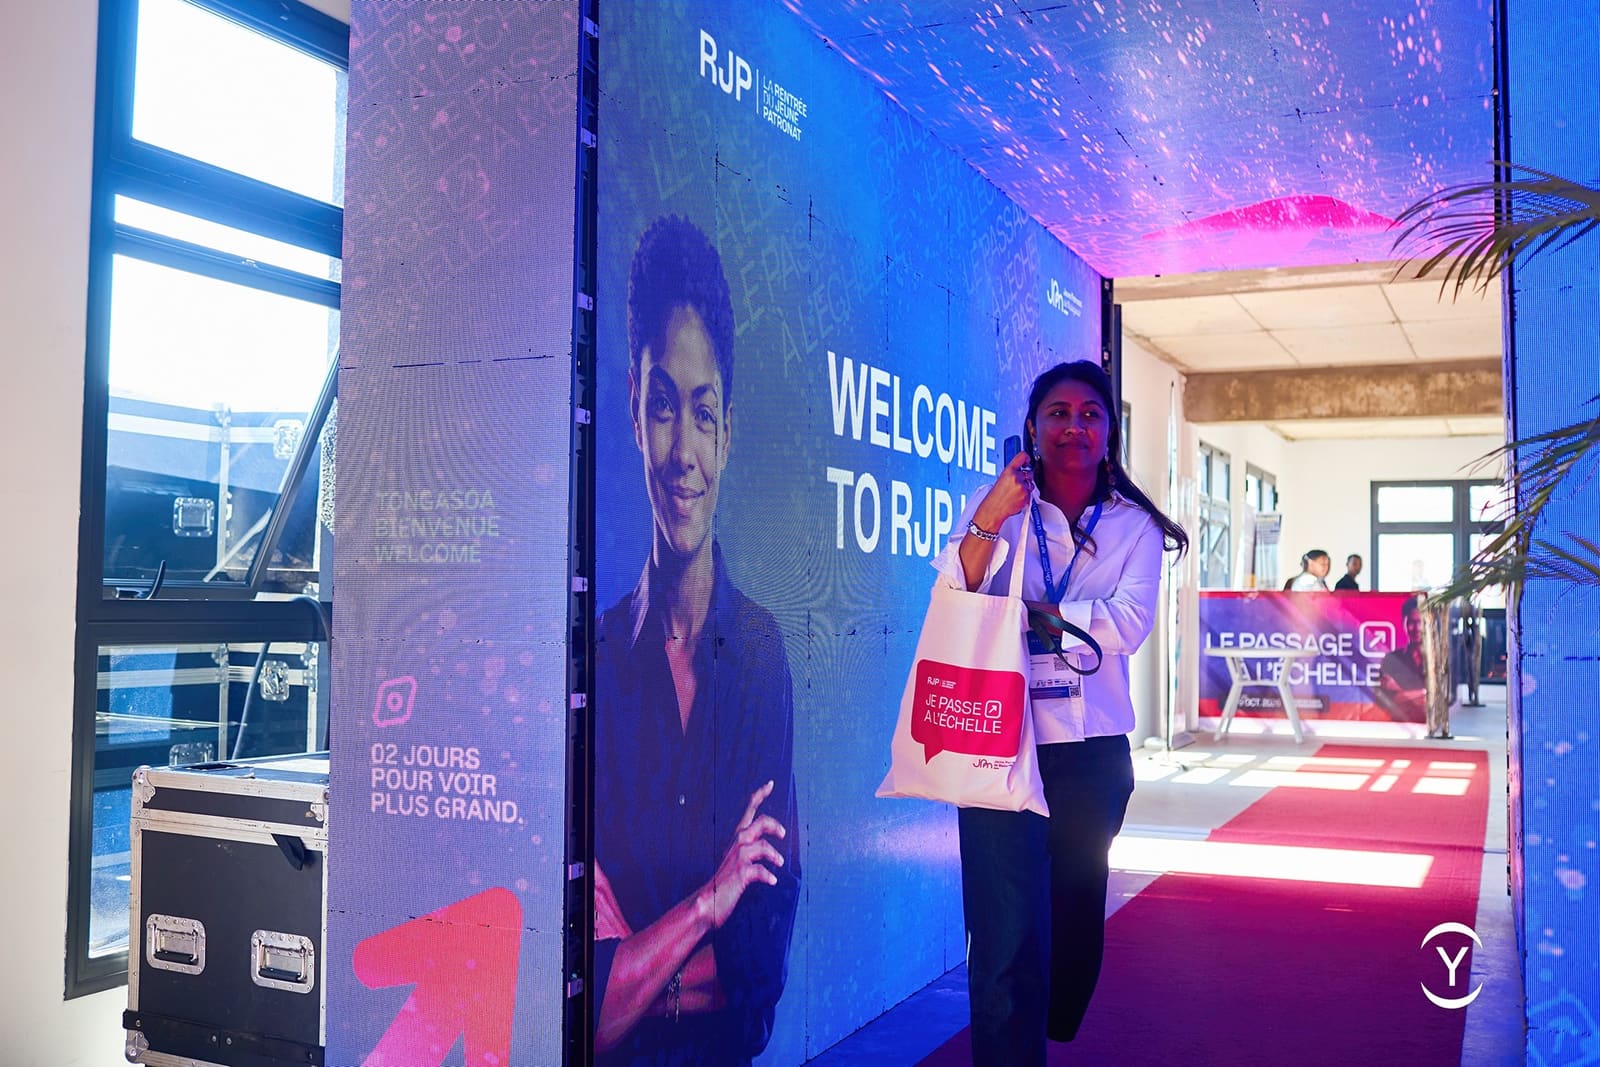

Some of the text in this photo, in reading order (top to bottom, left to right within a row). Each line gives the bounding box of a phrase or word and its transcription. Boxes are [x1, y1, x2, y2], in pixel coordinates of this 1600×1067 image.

[700, 28, 752, 102] RJP
[763, 75, 808, 118] LA RENTRÉE
[763, 90, 800, 126] DU JEUNE
[763, 105, 802, 142] PATRONAT
[827, 351, 997, 476] WELCOME
[827, 466, 881, 553] TO
[891, 480, 953, 557] RJP
[375, 516, 500, 538] BIENVENUE
[374, 543, 481, 562] WELCOME
[1239, 632, 1353, 657] PASSAGE
[927, 676, 940, 686] RJP
[925, 694, 983, 716] JE PASSE
[933, 710, 1002, 734] L'ÉCHELLE
[371, 743, 481, 769] 02 JOURS
[371, 767, 497, 796] POUR VOIR
[371, 792, 523, 824] PLUS GRAND.
